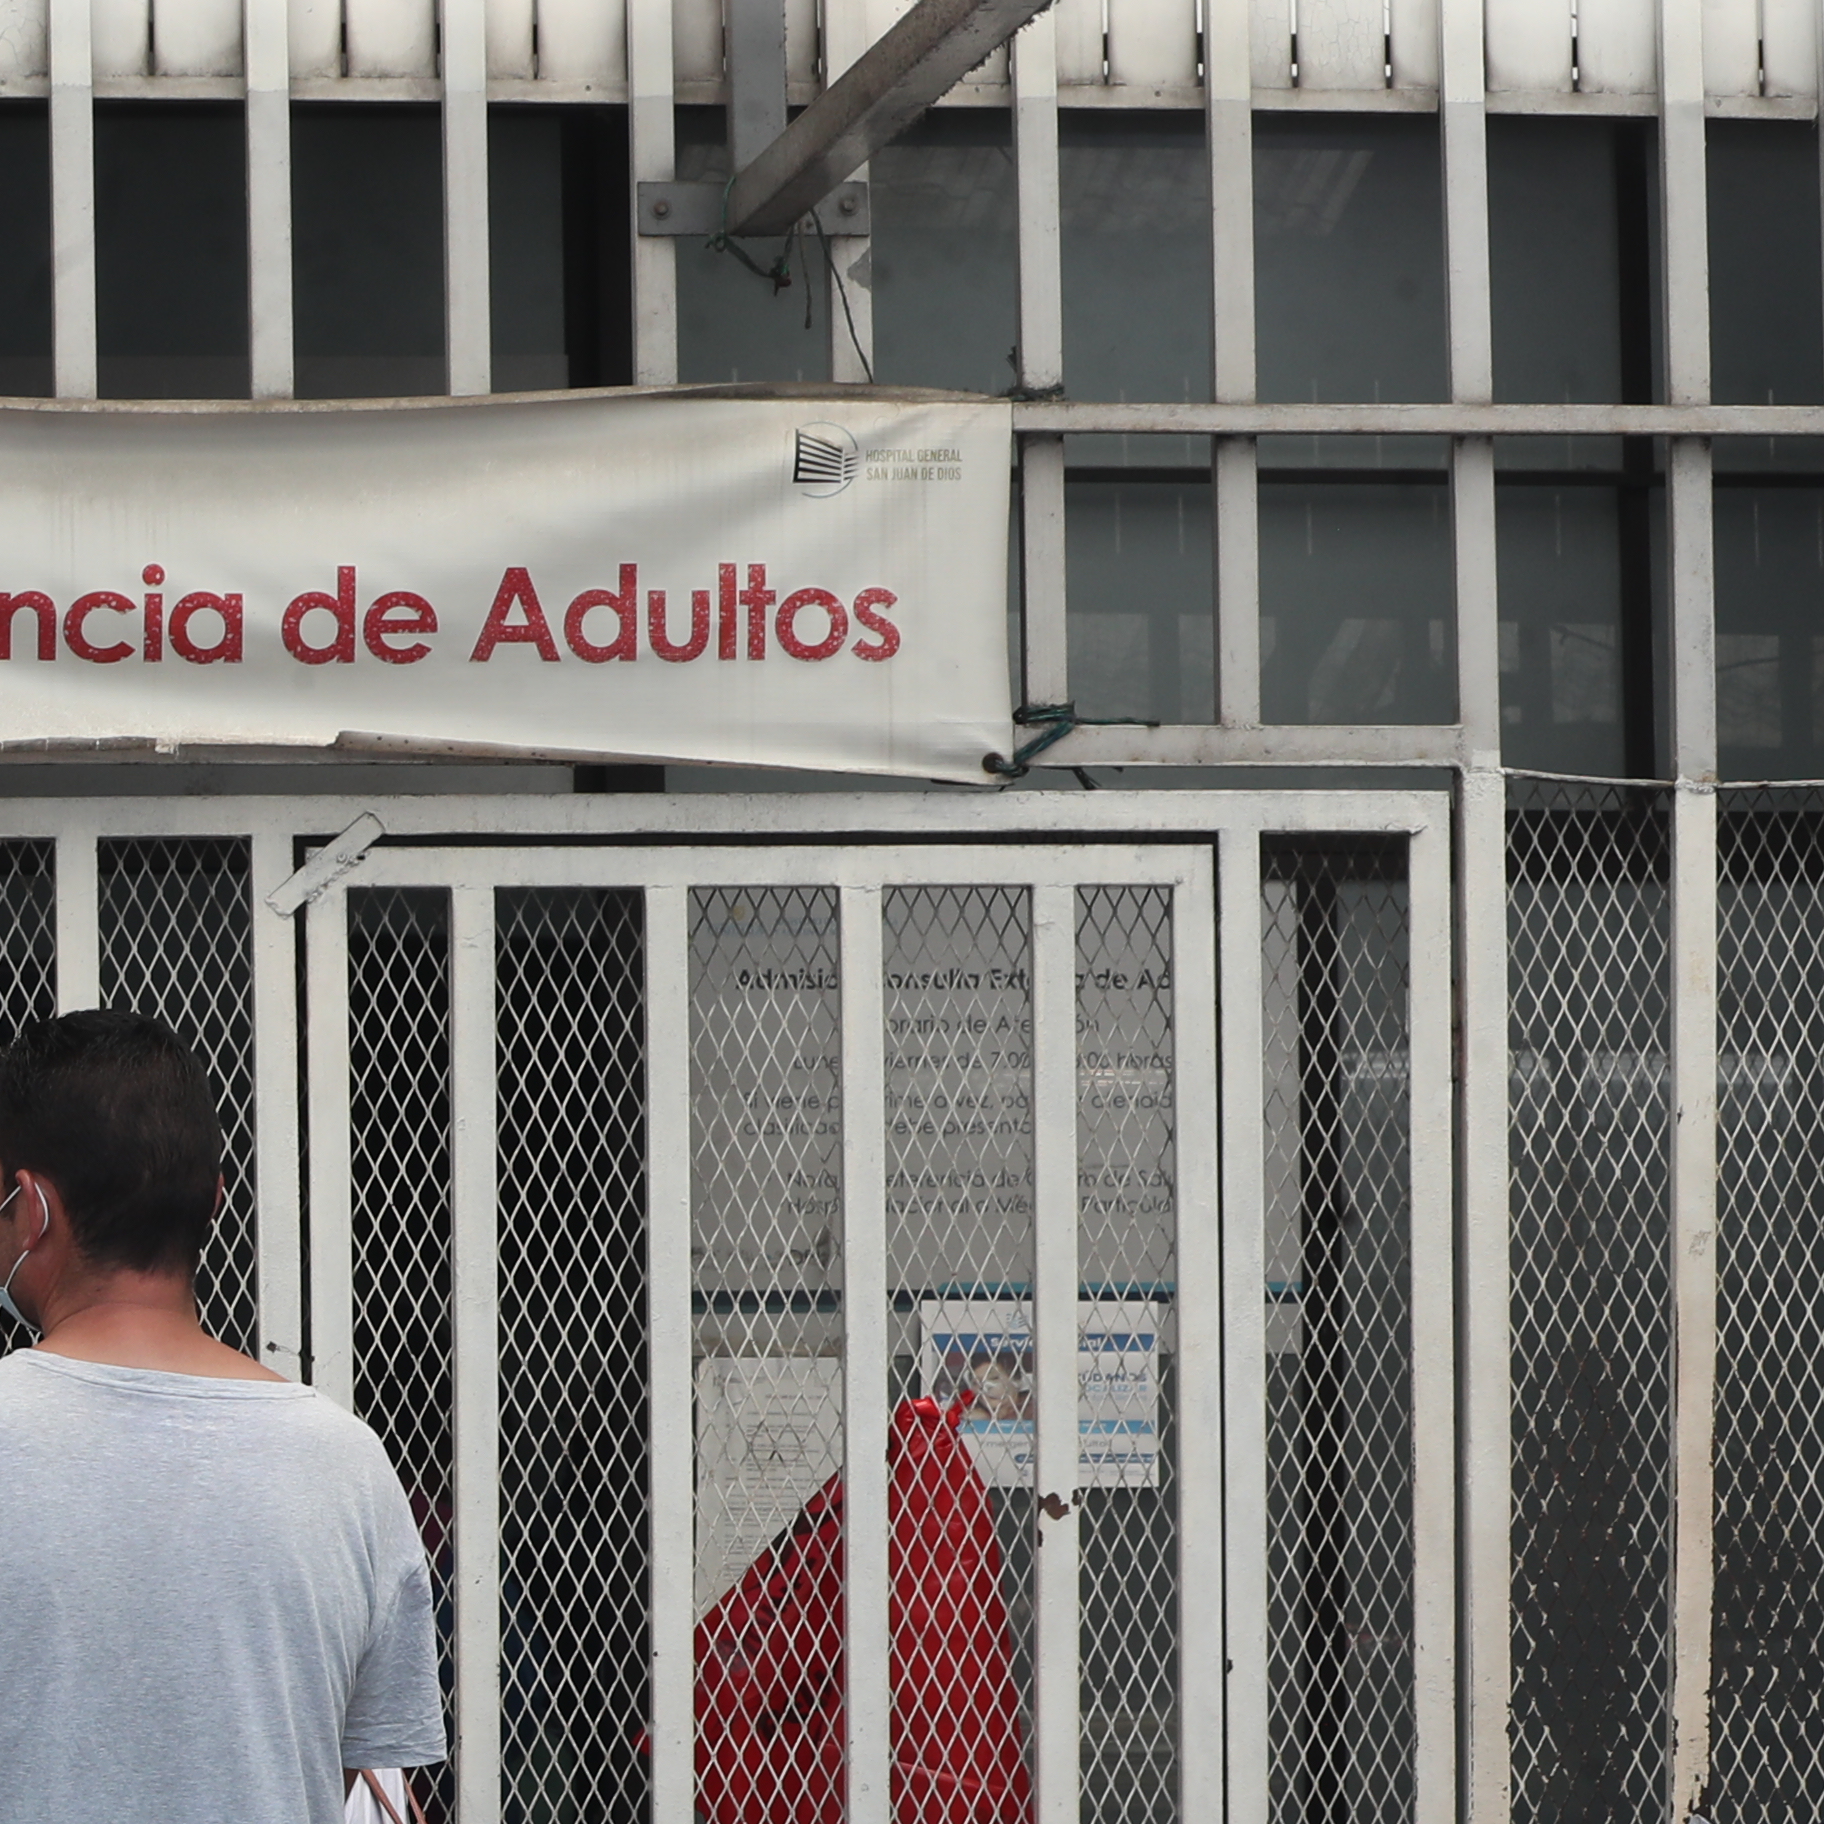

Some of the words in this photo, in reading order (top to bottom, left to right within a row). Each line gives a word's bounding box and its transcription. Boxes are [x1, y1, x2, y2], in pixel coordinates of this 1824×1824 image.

[865, 449, 915, 462] HOSPITAL
[918, 449, 962, 462] GENERAL
[866, 467, 888, 481] SAN
[891, 467, 917, 480] JUAN
[921, 467, 934, 480] DE
[938, 467, 962, 480] DIOS
[281, 565, 439, 665] de
[469, 562, 902, 663] Adultos
